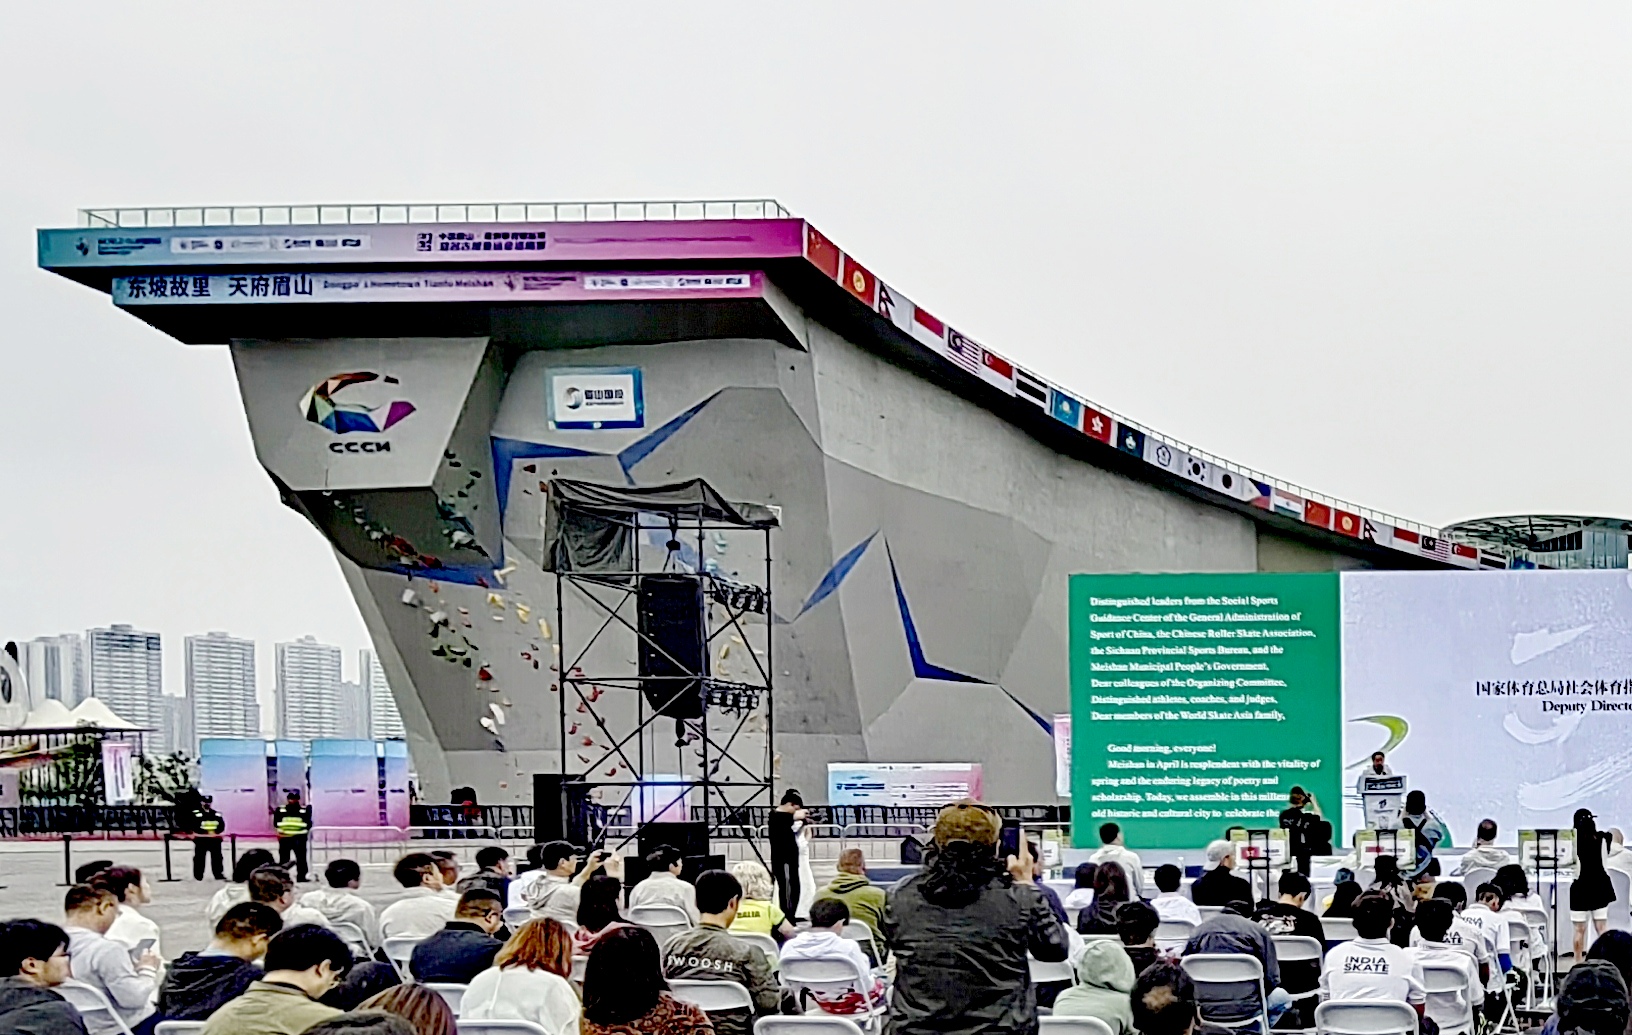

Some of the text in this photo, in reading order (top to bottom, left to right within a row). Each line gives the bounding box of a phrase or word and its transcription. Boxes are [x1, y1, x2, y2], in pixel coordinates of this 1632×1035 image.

[128, 275, 313, 299] 东坡故里 天府眉山
[1542, 700, 1587, 714] Deputy
[668, 955, 734, 972] SWOOSH
[1345, 956, 1386, 964] INDIA
[1344, 964, 1389, 972] SKATE
